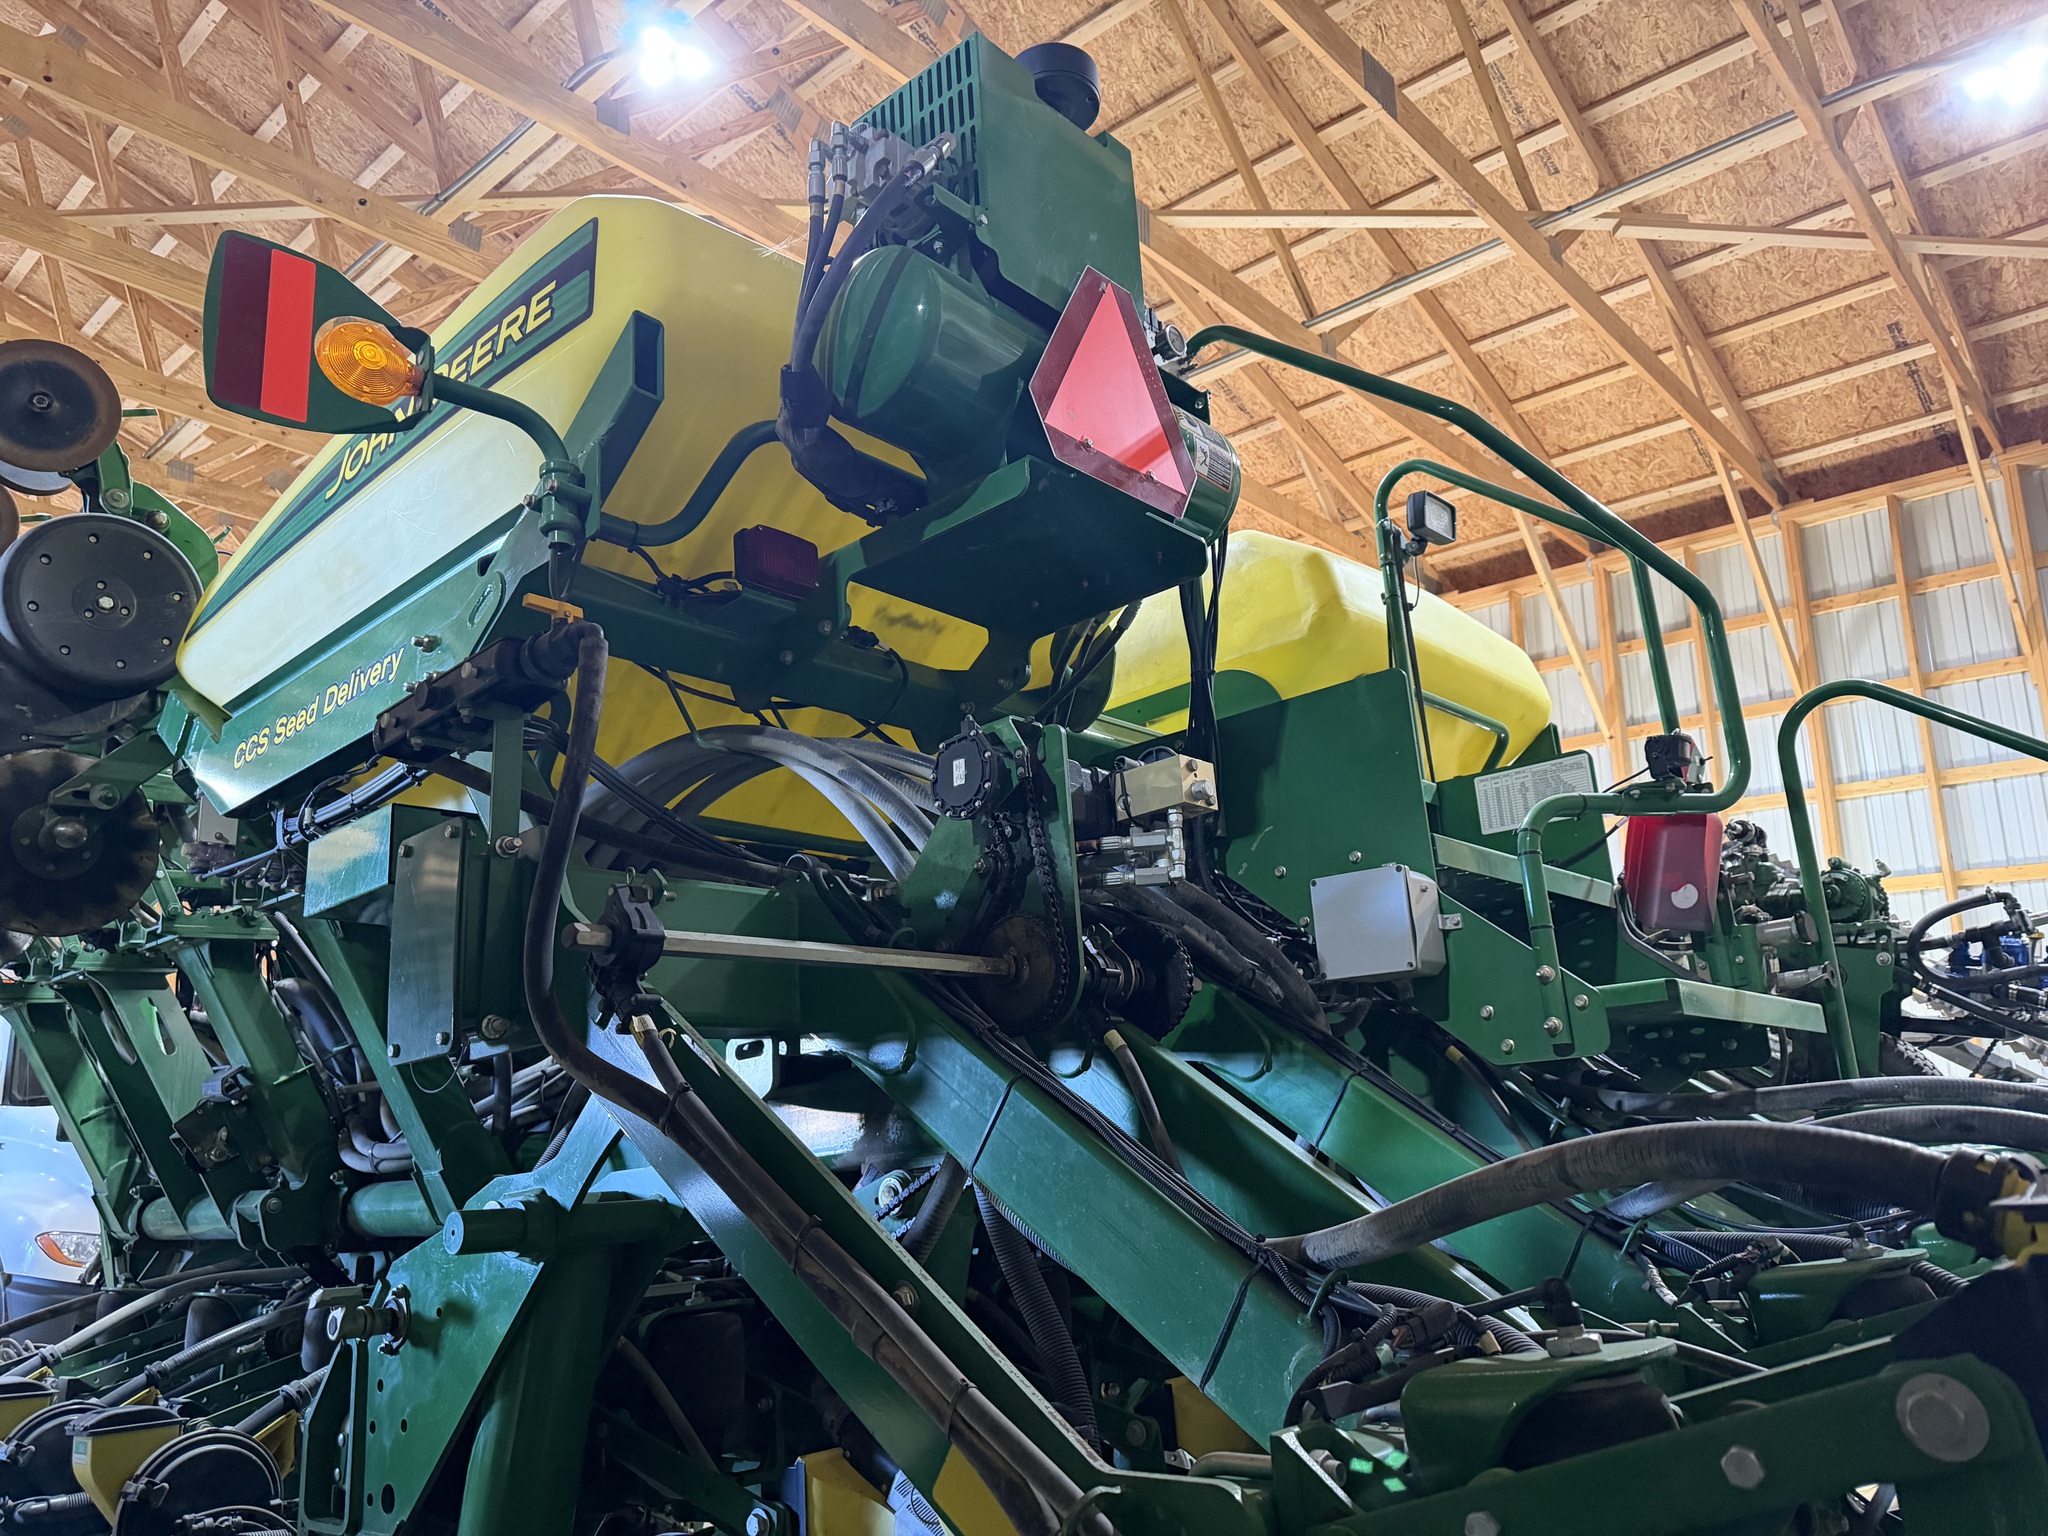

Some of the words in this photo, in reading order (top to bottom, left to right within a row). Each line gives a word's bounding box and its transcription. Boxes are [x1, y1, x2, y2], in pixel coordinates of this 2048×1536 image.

[233, 726, 270, 769] CCS
[274, 695, 319, 744] Seed
[323, 647, 404, 715] Delivery
